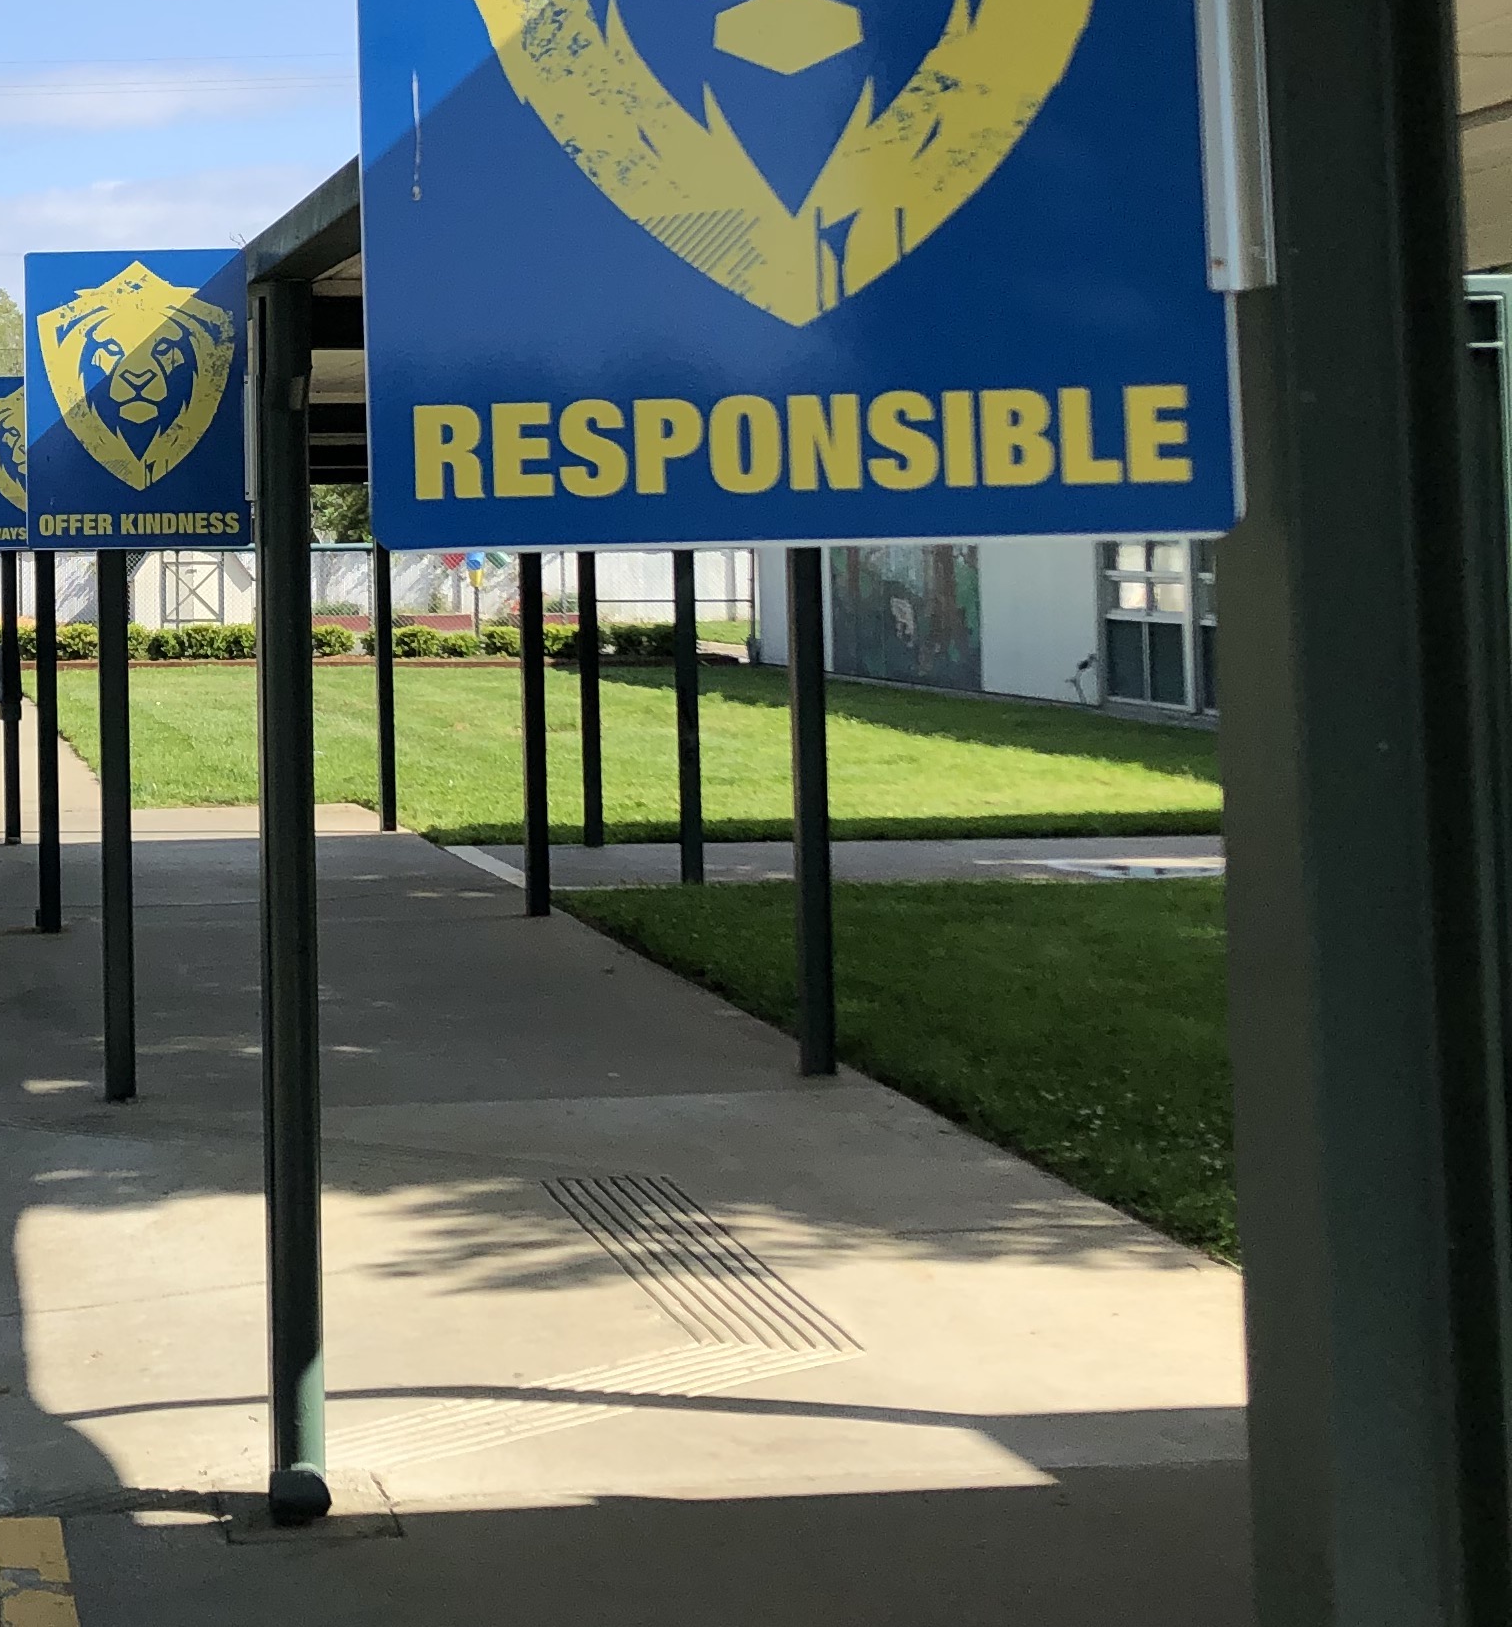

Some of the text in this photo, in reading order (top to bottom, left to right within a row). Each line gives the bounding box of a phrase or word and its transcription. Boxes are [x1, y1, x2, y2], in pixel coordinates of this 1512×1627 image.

[412, 384, 1193, 500] RESPONSIBLE
[39, 512, 241, 536] OFFER KINDNESS
